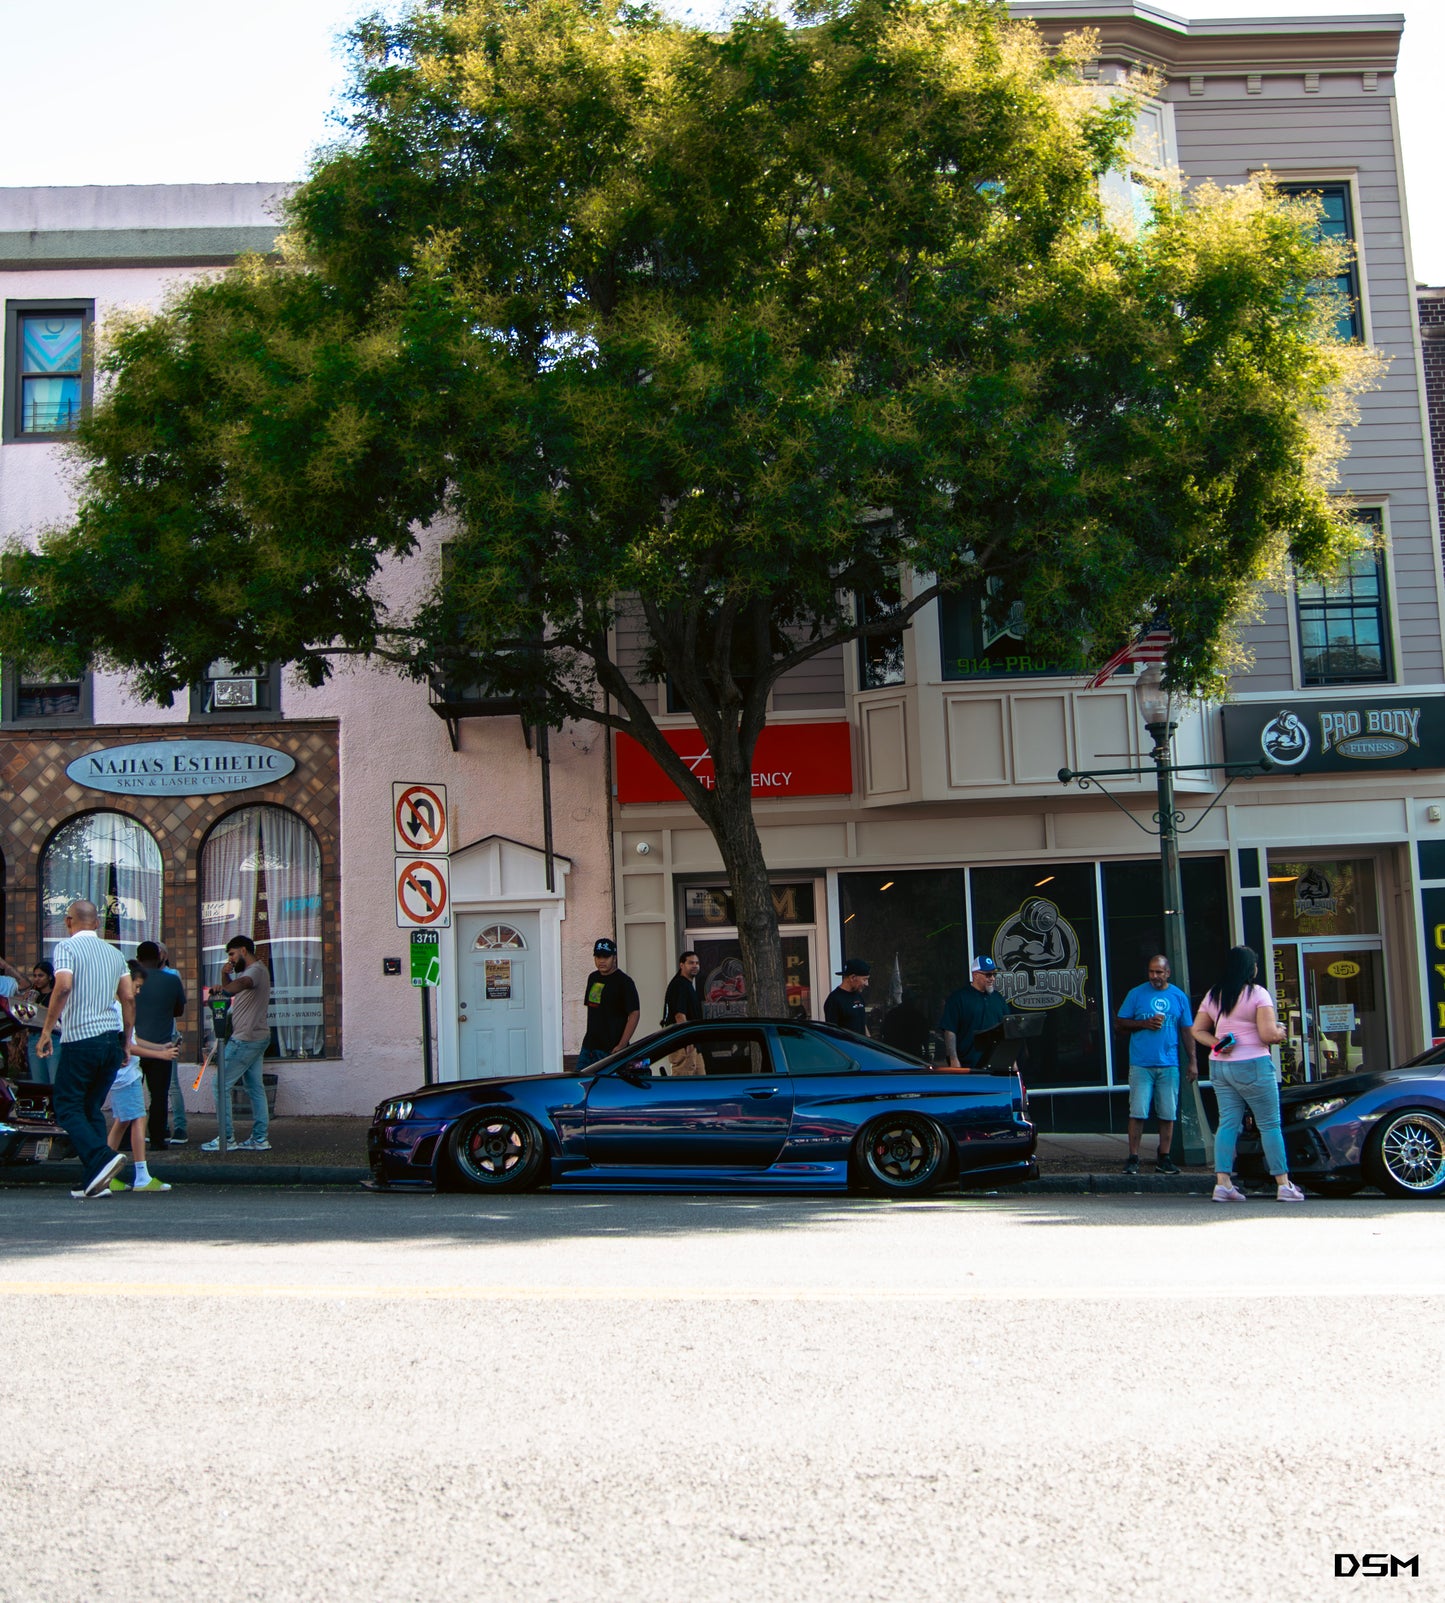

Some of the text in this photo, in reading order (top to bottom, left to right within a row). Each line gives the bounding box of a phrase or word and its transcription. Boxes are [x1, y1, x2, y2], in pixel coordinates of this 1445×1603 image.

[1318, 708, 1421, 754] PRO BODY
[1350, 743, 1395, 753] FITNESS
[89, 754, 278, 775] NAJIA'S ESTHETIC
[117, 775, 249, 787] SKIN & LASER CENTER
[697, 771, 793, 789] TH ENCY
[416, 933, 437, 943] 3711
[1033, 968, 1087, 1005] BODY
[1022, 996, 1055, 1005] FITNESS
